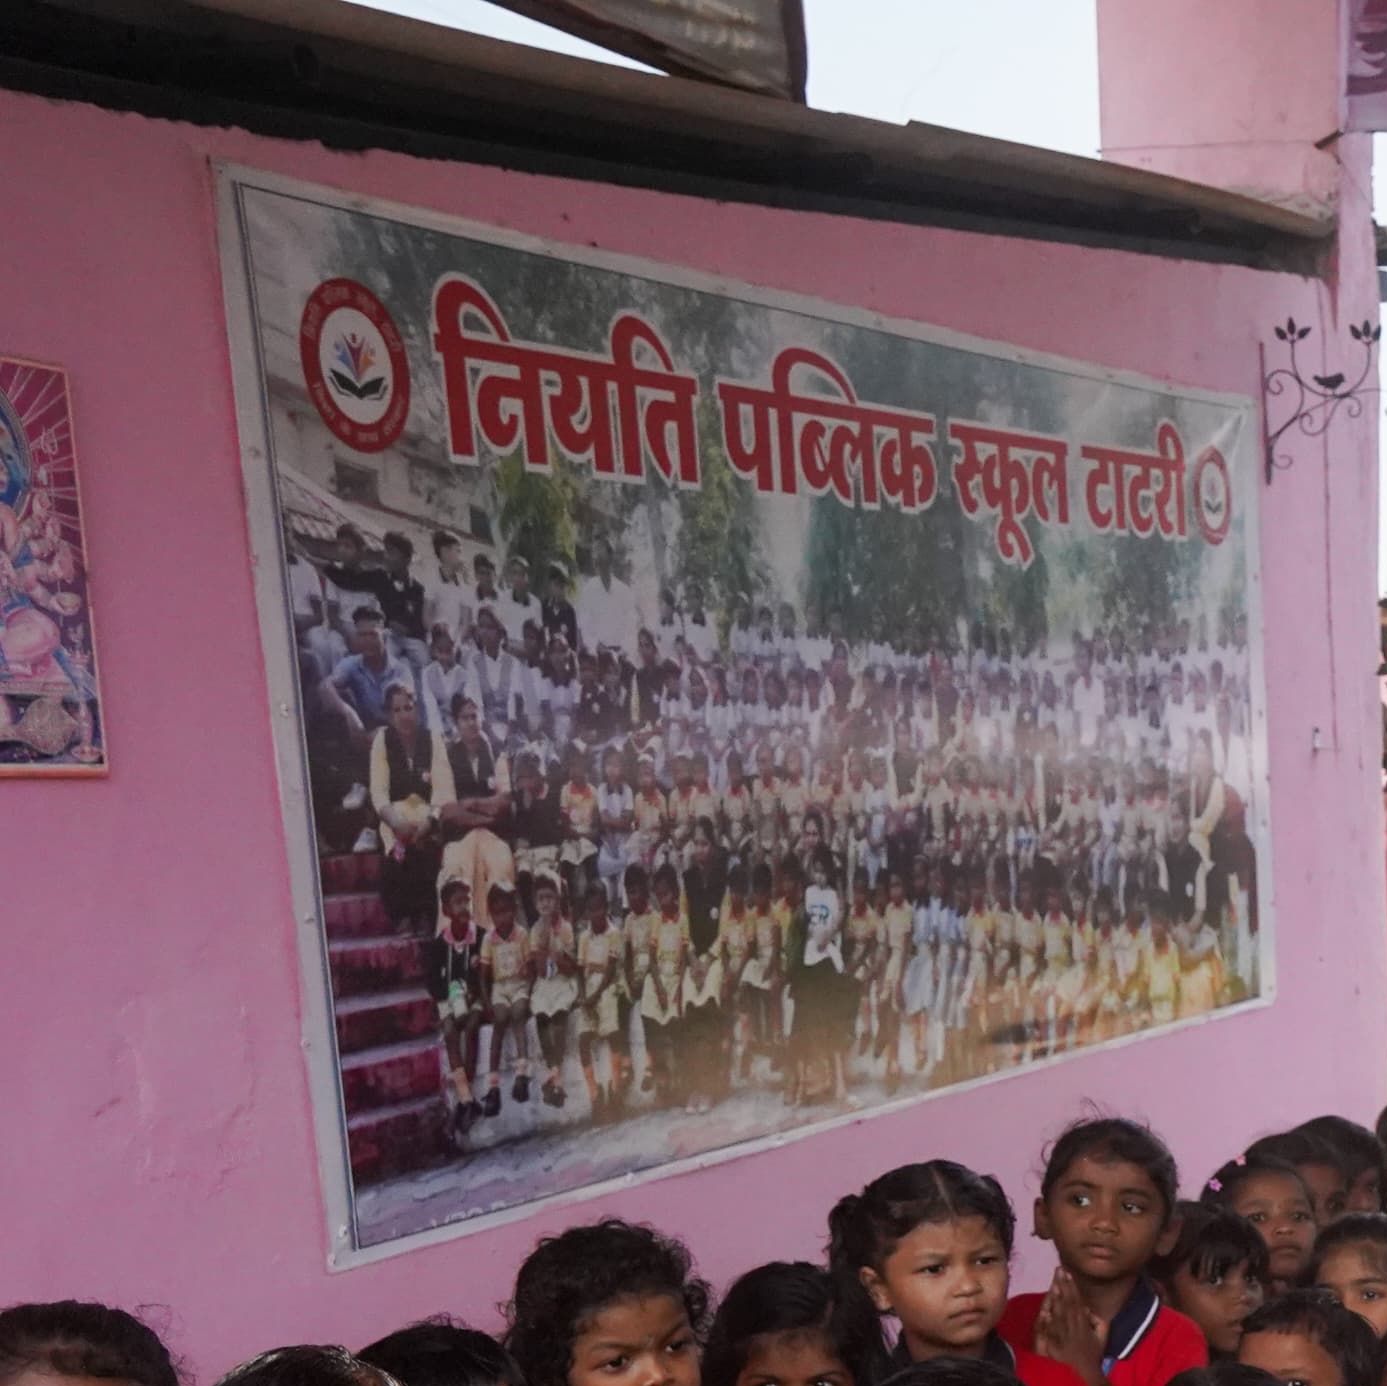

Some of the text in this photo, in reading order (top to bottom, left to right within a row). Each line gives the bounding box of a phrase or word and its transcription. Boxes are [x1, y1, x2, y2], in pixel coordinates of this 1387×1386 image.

[433, 274, 701, 487] नियति
[715, 346, 937, 512] पब्लिक
[948, 420, 1070, 567] स्कूल
[1080, 419, 1187, 538] टाटरी
